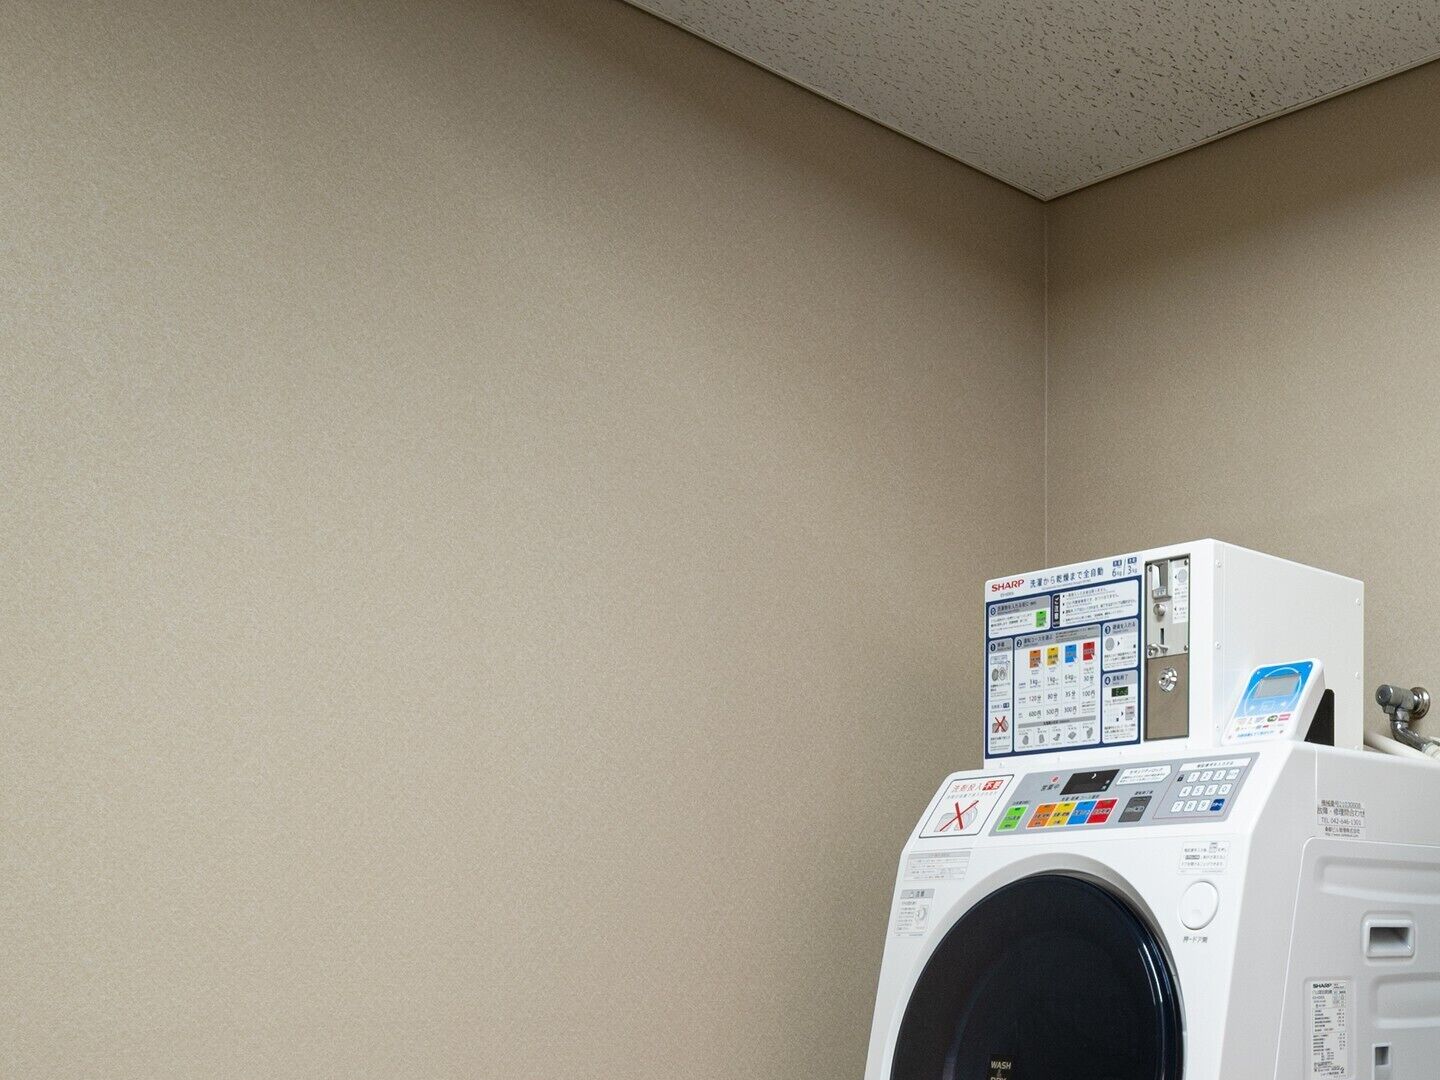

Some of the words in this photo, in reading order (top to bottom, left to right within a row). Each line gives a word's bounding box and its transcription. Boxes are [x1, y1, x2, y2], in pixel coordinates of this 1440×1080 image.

[1030, 567, 1104, 589] 洗濯から乾燥まで全自動
[991, 579, 1024, 592] SHARP
[991, 1061, 1011, 1070] WASH
